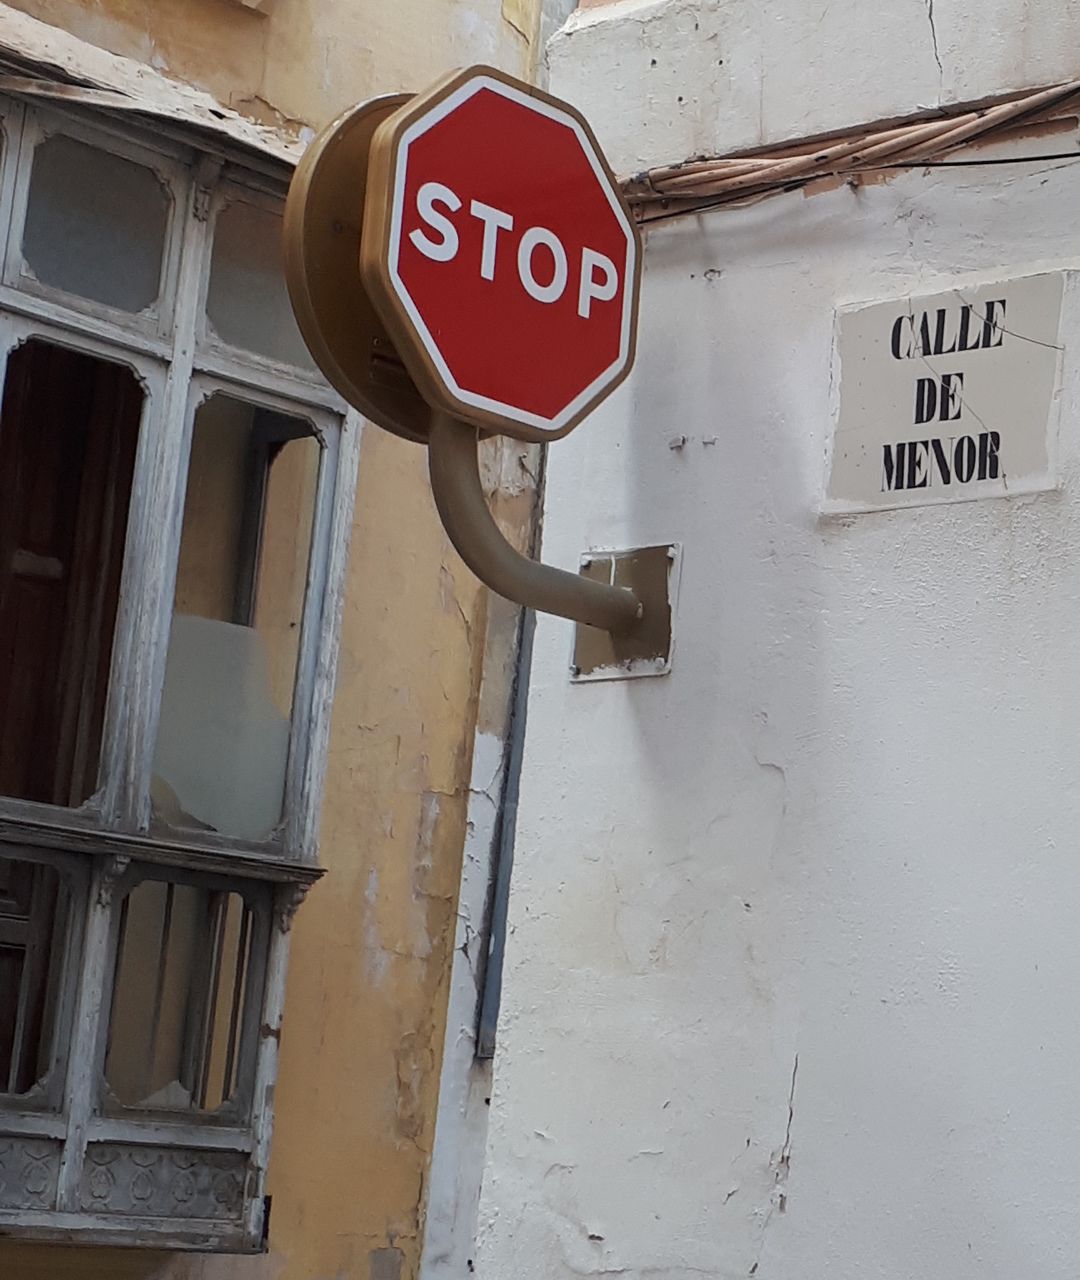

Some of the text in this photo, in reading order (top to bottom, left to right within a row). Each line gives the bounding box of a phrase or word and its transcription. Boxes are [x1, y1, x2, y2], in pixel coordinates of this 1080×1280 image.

[408, 182, 618, 319] STOP
[891, 299, 1006, 360] CALLE
[914, 372, 964, 424] DE
[881, 431, 1001, 492] MENOR
